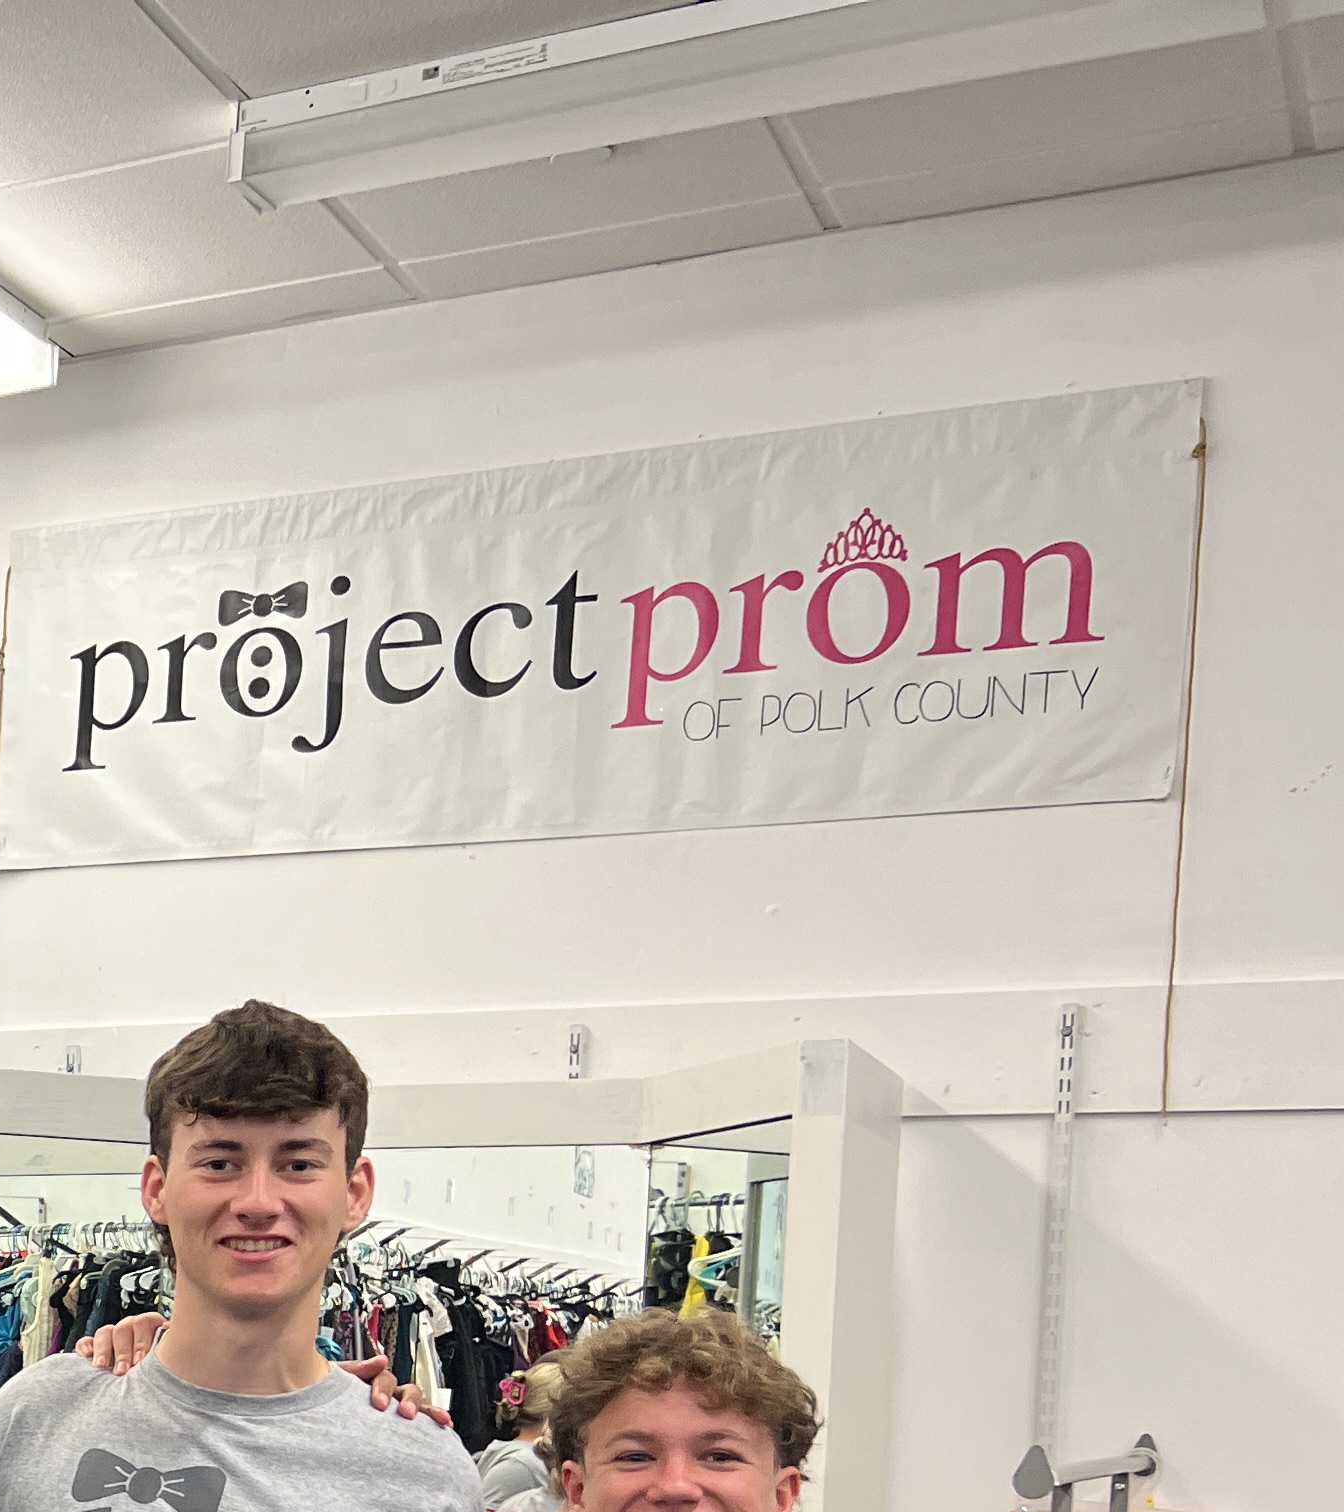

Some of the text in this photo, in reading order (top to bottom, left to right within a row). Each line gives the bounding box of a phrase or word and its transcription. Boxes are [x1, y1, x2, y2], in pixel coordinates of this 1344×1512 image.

[61, 540, 1105, 772] project prom
[683, 666, 1099, 741] OF POLK COUNTY
